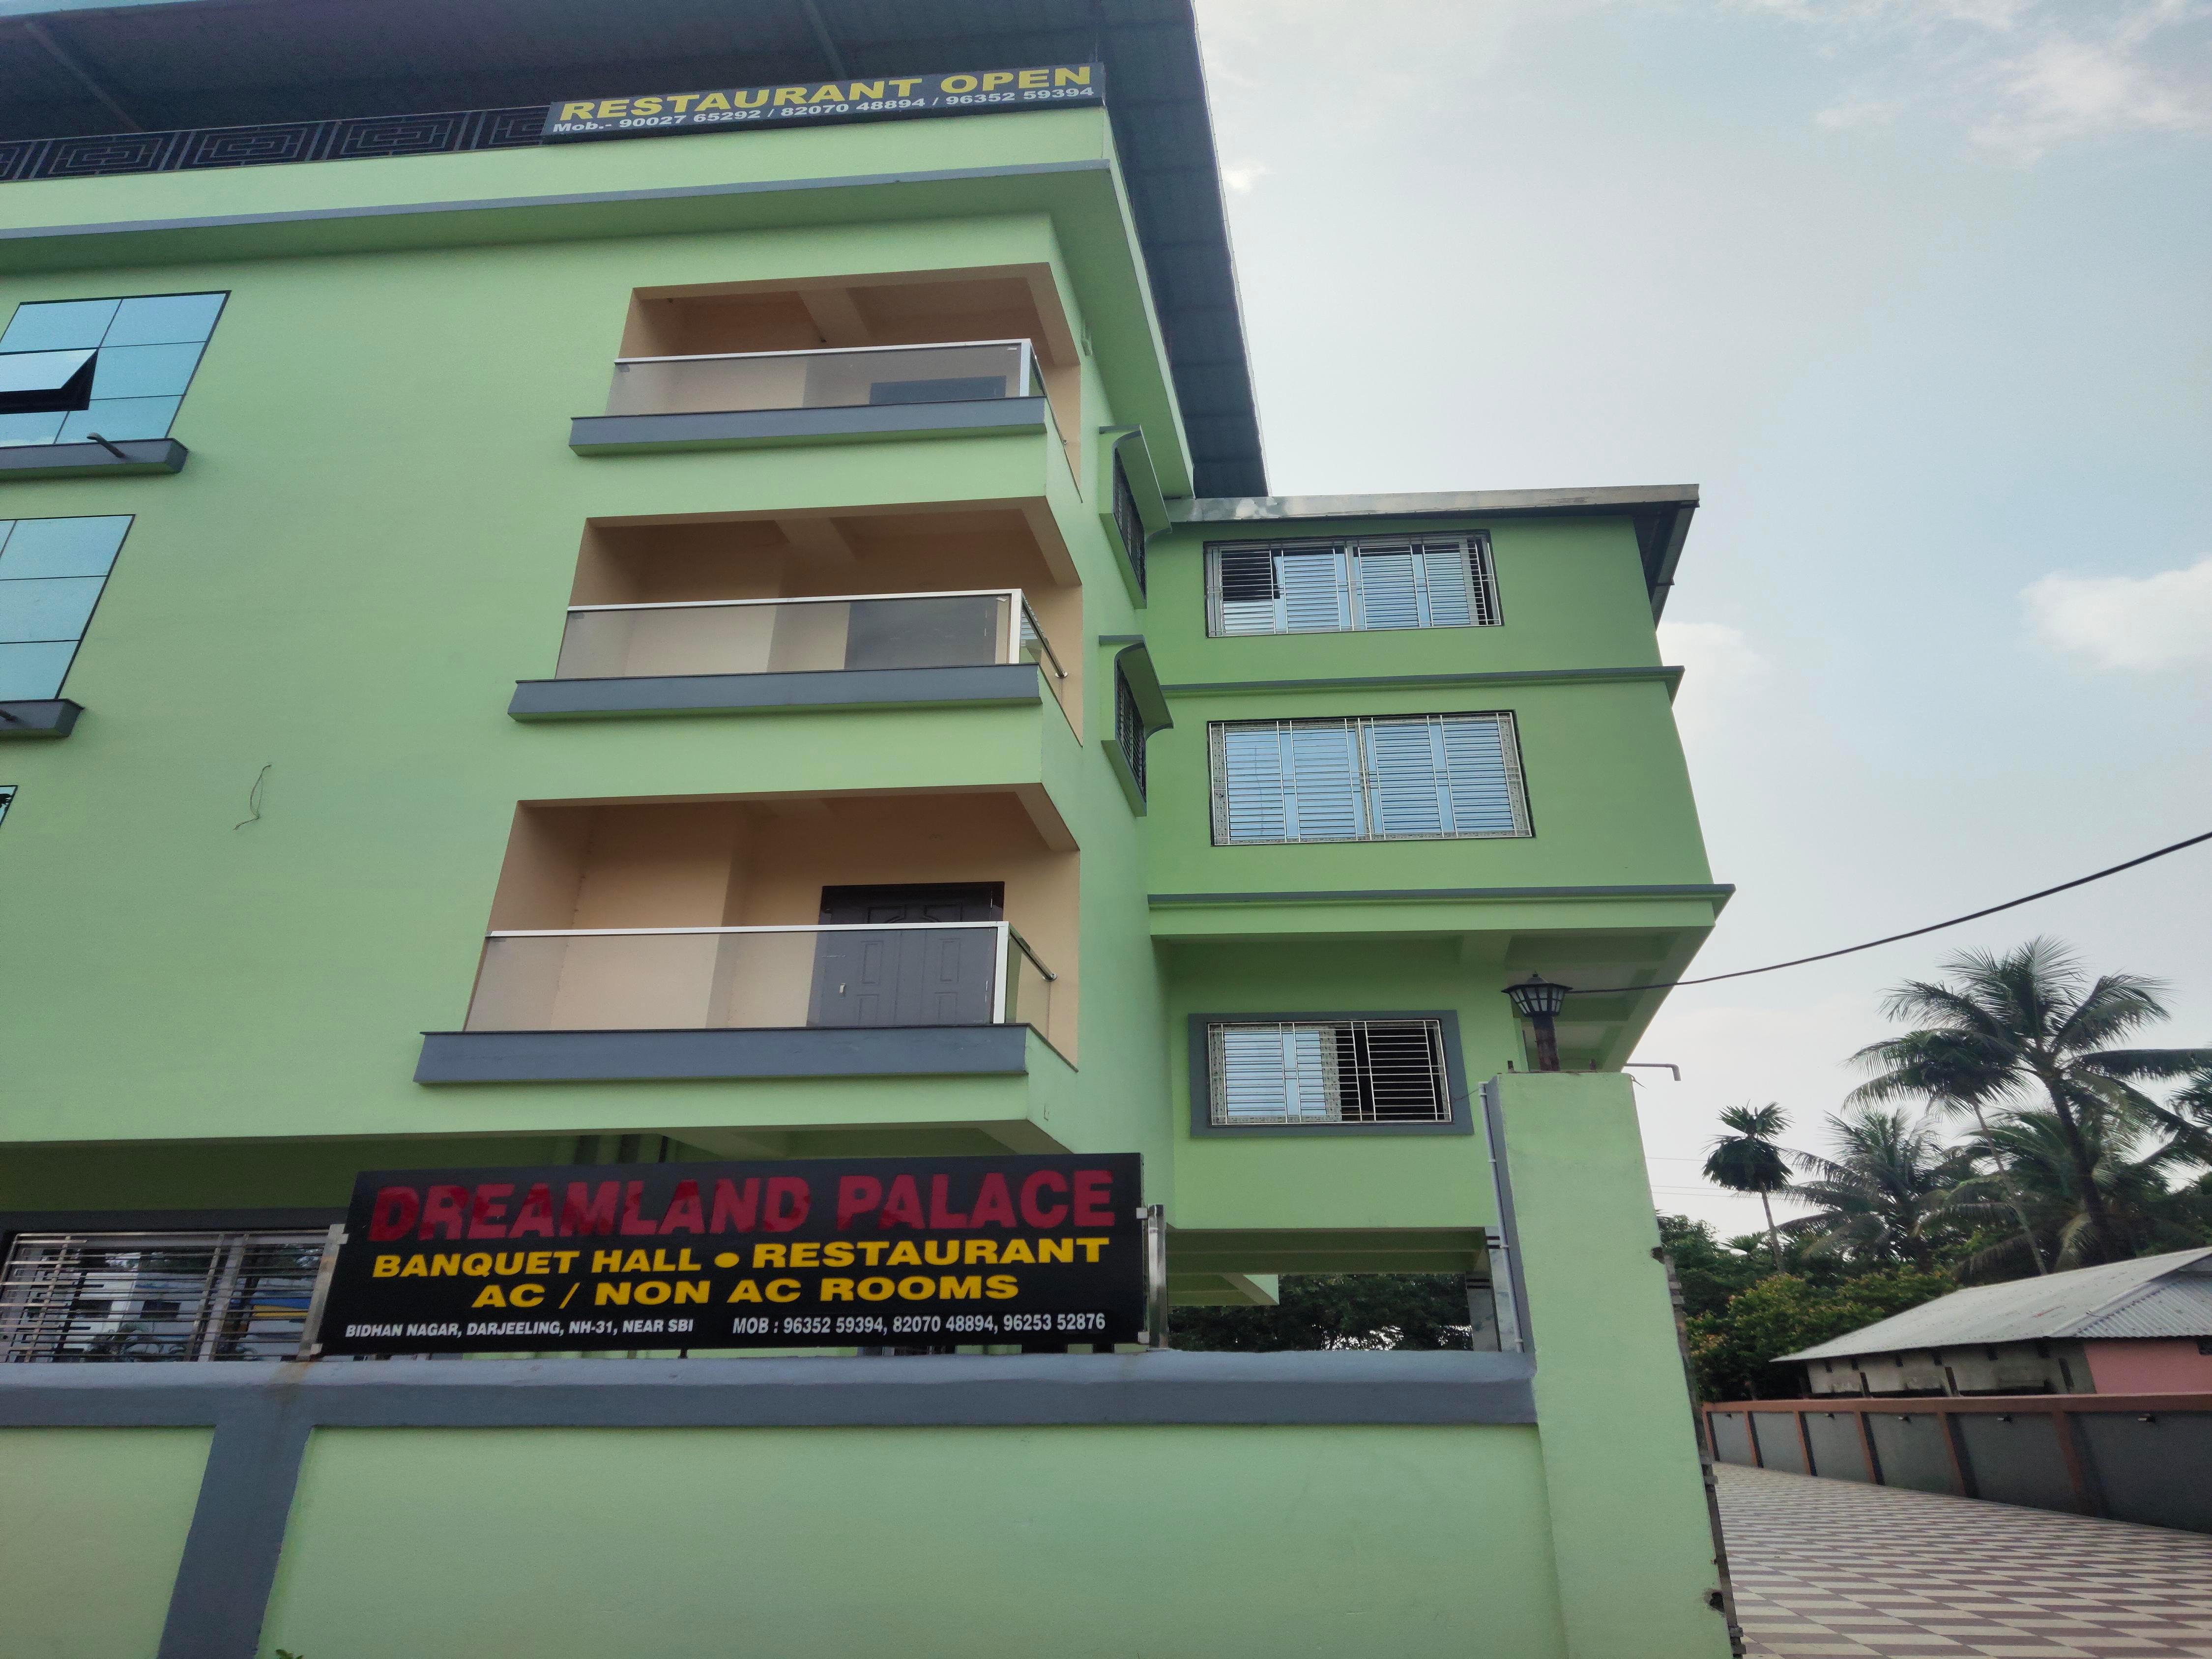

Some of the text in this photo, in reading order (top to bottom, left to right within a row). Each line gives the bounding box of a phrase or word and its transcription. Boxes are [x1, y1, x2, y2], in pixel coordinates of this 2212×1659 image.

[553, 121, 612, 132] Mob.-
[619, 113, 687, 128] 90027
[693, 110, 761, 123] 65292
[781, 102, 849, 116] 82070
[856, 98, 926, 111] 48894
[945, 91, 1015, 105] 96352
[1023, 87, 1094, 100] 59394
[560, 67, 1090, 120] RESTAURANT OPEN
[369, 1169, 1115, 1242] DREAMLAND PALACE
[373, 1237, 1109, 1278] BANQUET HALL RESTAURANT
[471, 1283, 545, 1308] AC
[595, 1281, 710, 1306] NON
[727, 1278, 801, 1303] AC
[820, 1275, 1019, 1301] ROOMS
[346, 1319, 694, 1338] BIDHAN NAGAR, DARJEELING, NH-31, NEAR SBI
[733, 1318, 769, 1334] MOB
[784, 1317, 831, 1334] 96352
[836, 1317, 888, 1336] 59394,
[893, 1316, 941, 1332] 82070
[946, 1315, 998, 1334] 48894,
[1003, 1314, 1051, 1331] 96253
[1057, 1313, 1105, 1330] 52876
